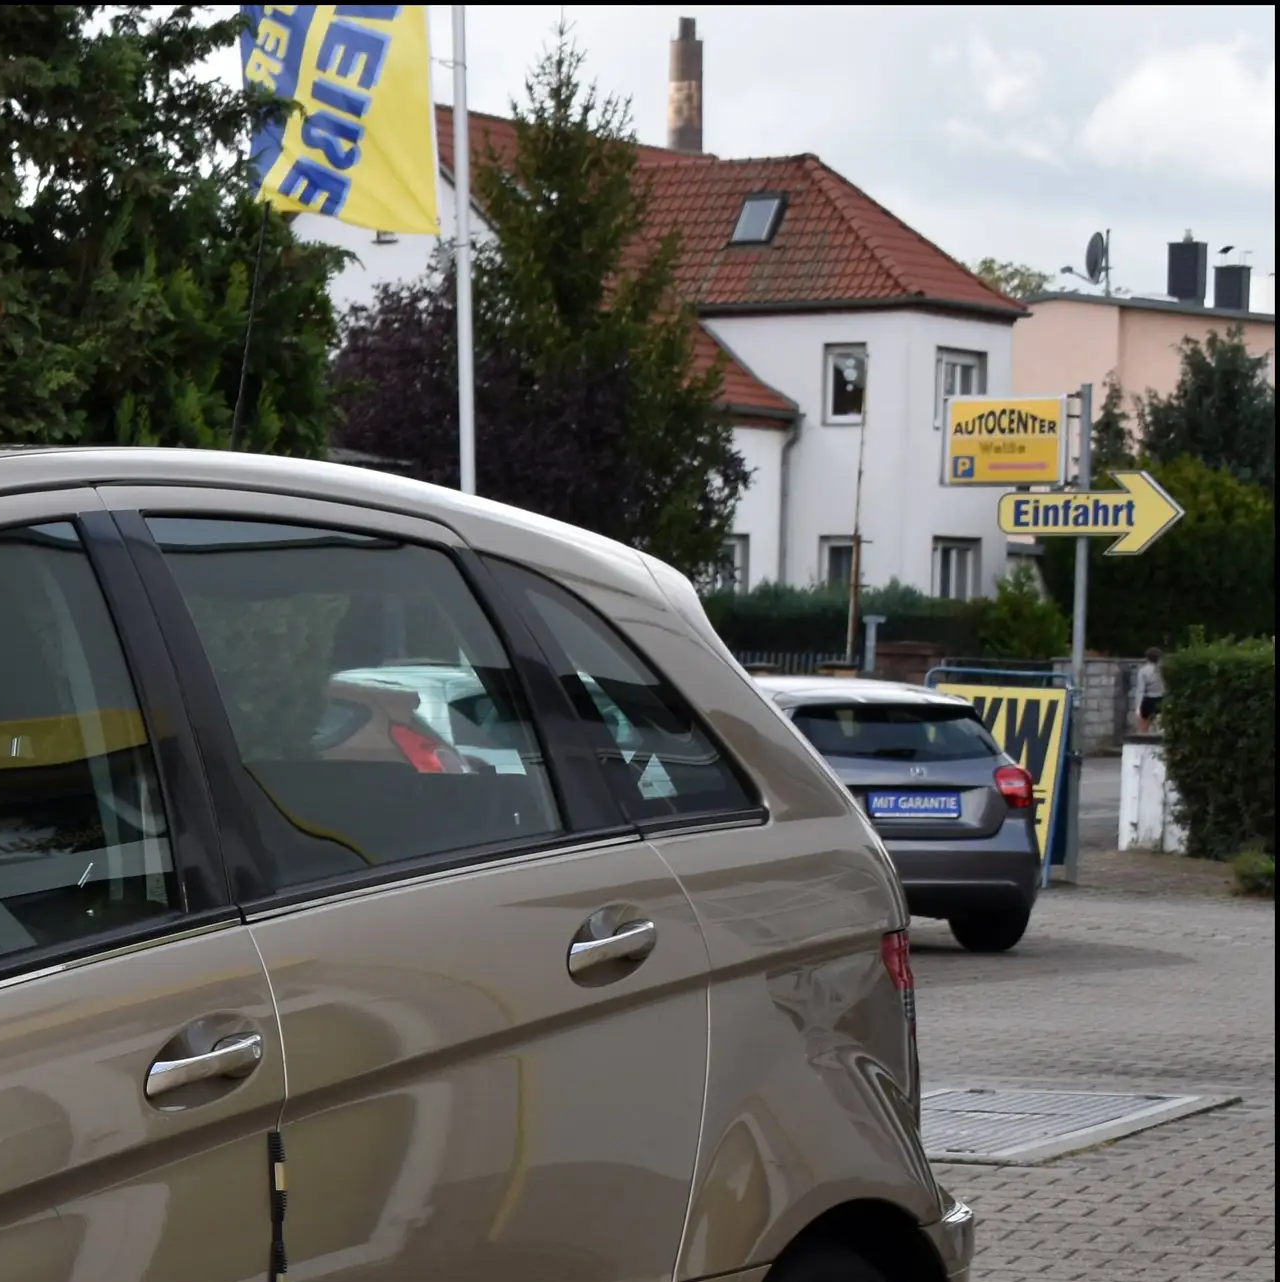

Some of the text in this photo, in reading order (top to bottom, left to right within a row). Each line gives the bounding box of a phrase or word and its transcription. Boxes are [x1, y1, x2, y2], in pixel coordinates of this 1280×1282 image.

[953, 408, 1057, 436] AUTOCENTER
[1013, 499, 1135, 527] Einfahrt
[872, 796, 958, 809] MIT GARANTIE
